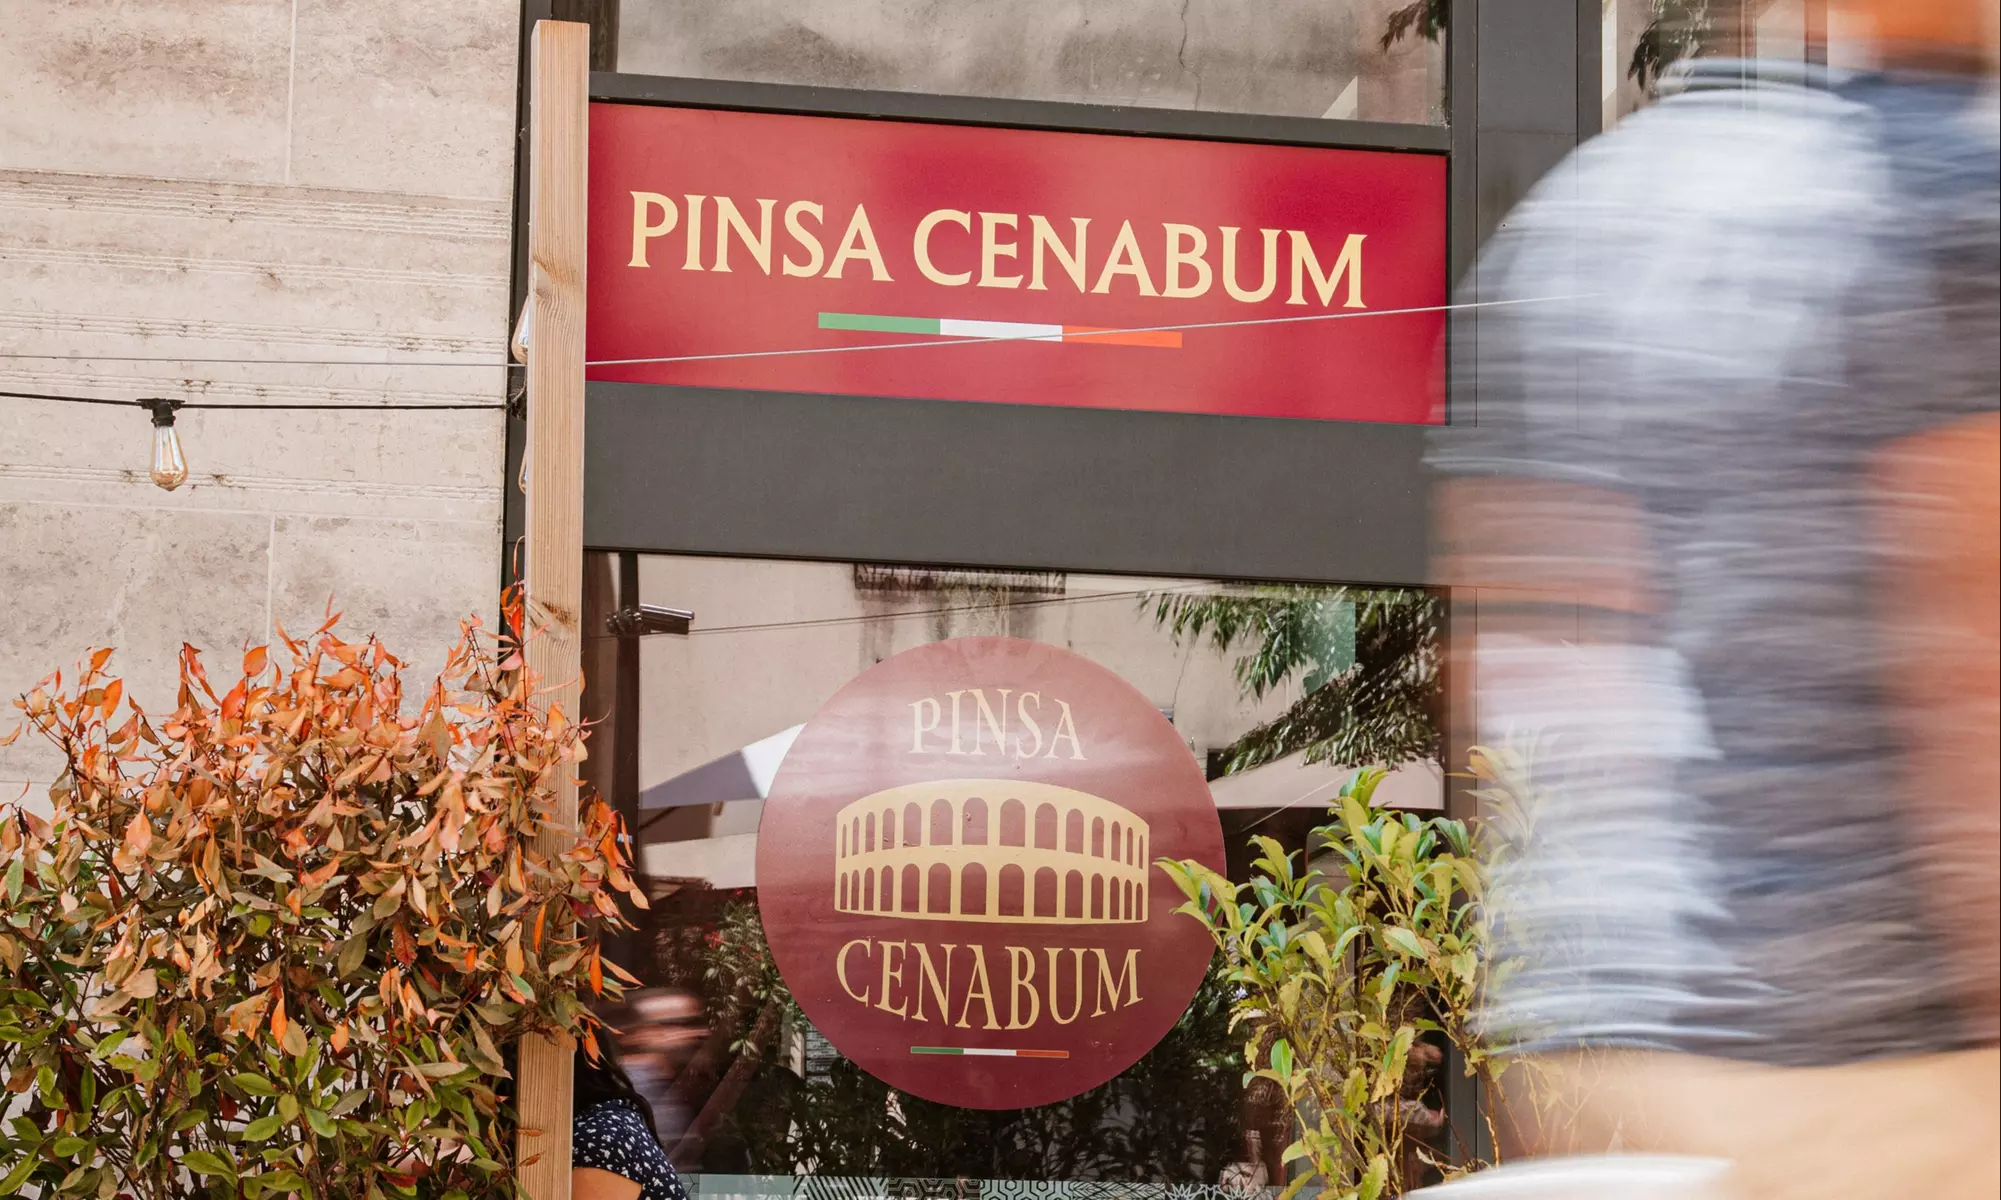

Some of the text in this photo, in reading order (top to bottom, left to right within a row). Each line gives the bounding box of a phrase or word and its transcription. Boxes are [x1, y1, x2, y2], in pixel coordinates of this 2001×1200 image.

[628, 192, 1367, 308] PINSA CENABUM
[909, 689, 1087, 760] PINSA
[837, 938, 1143, 1030] CENABUM
